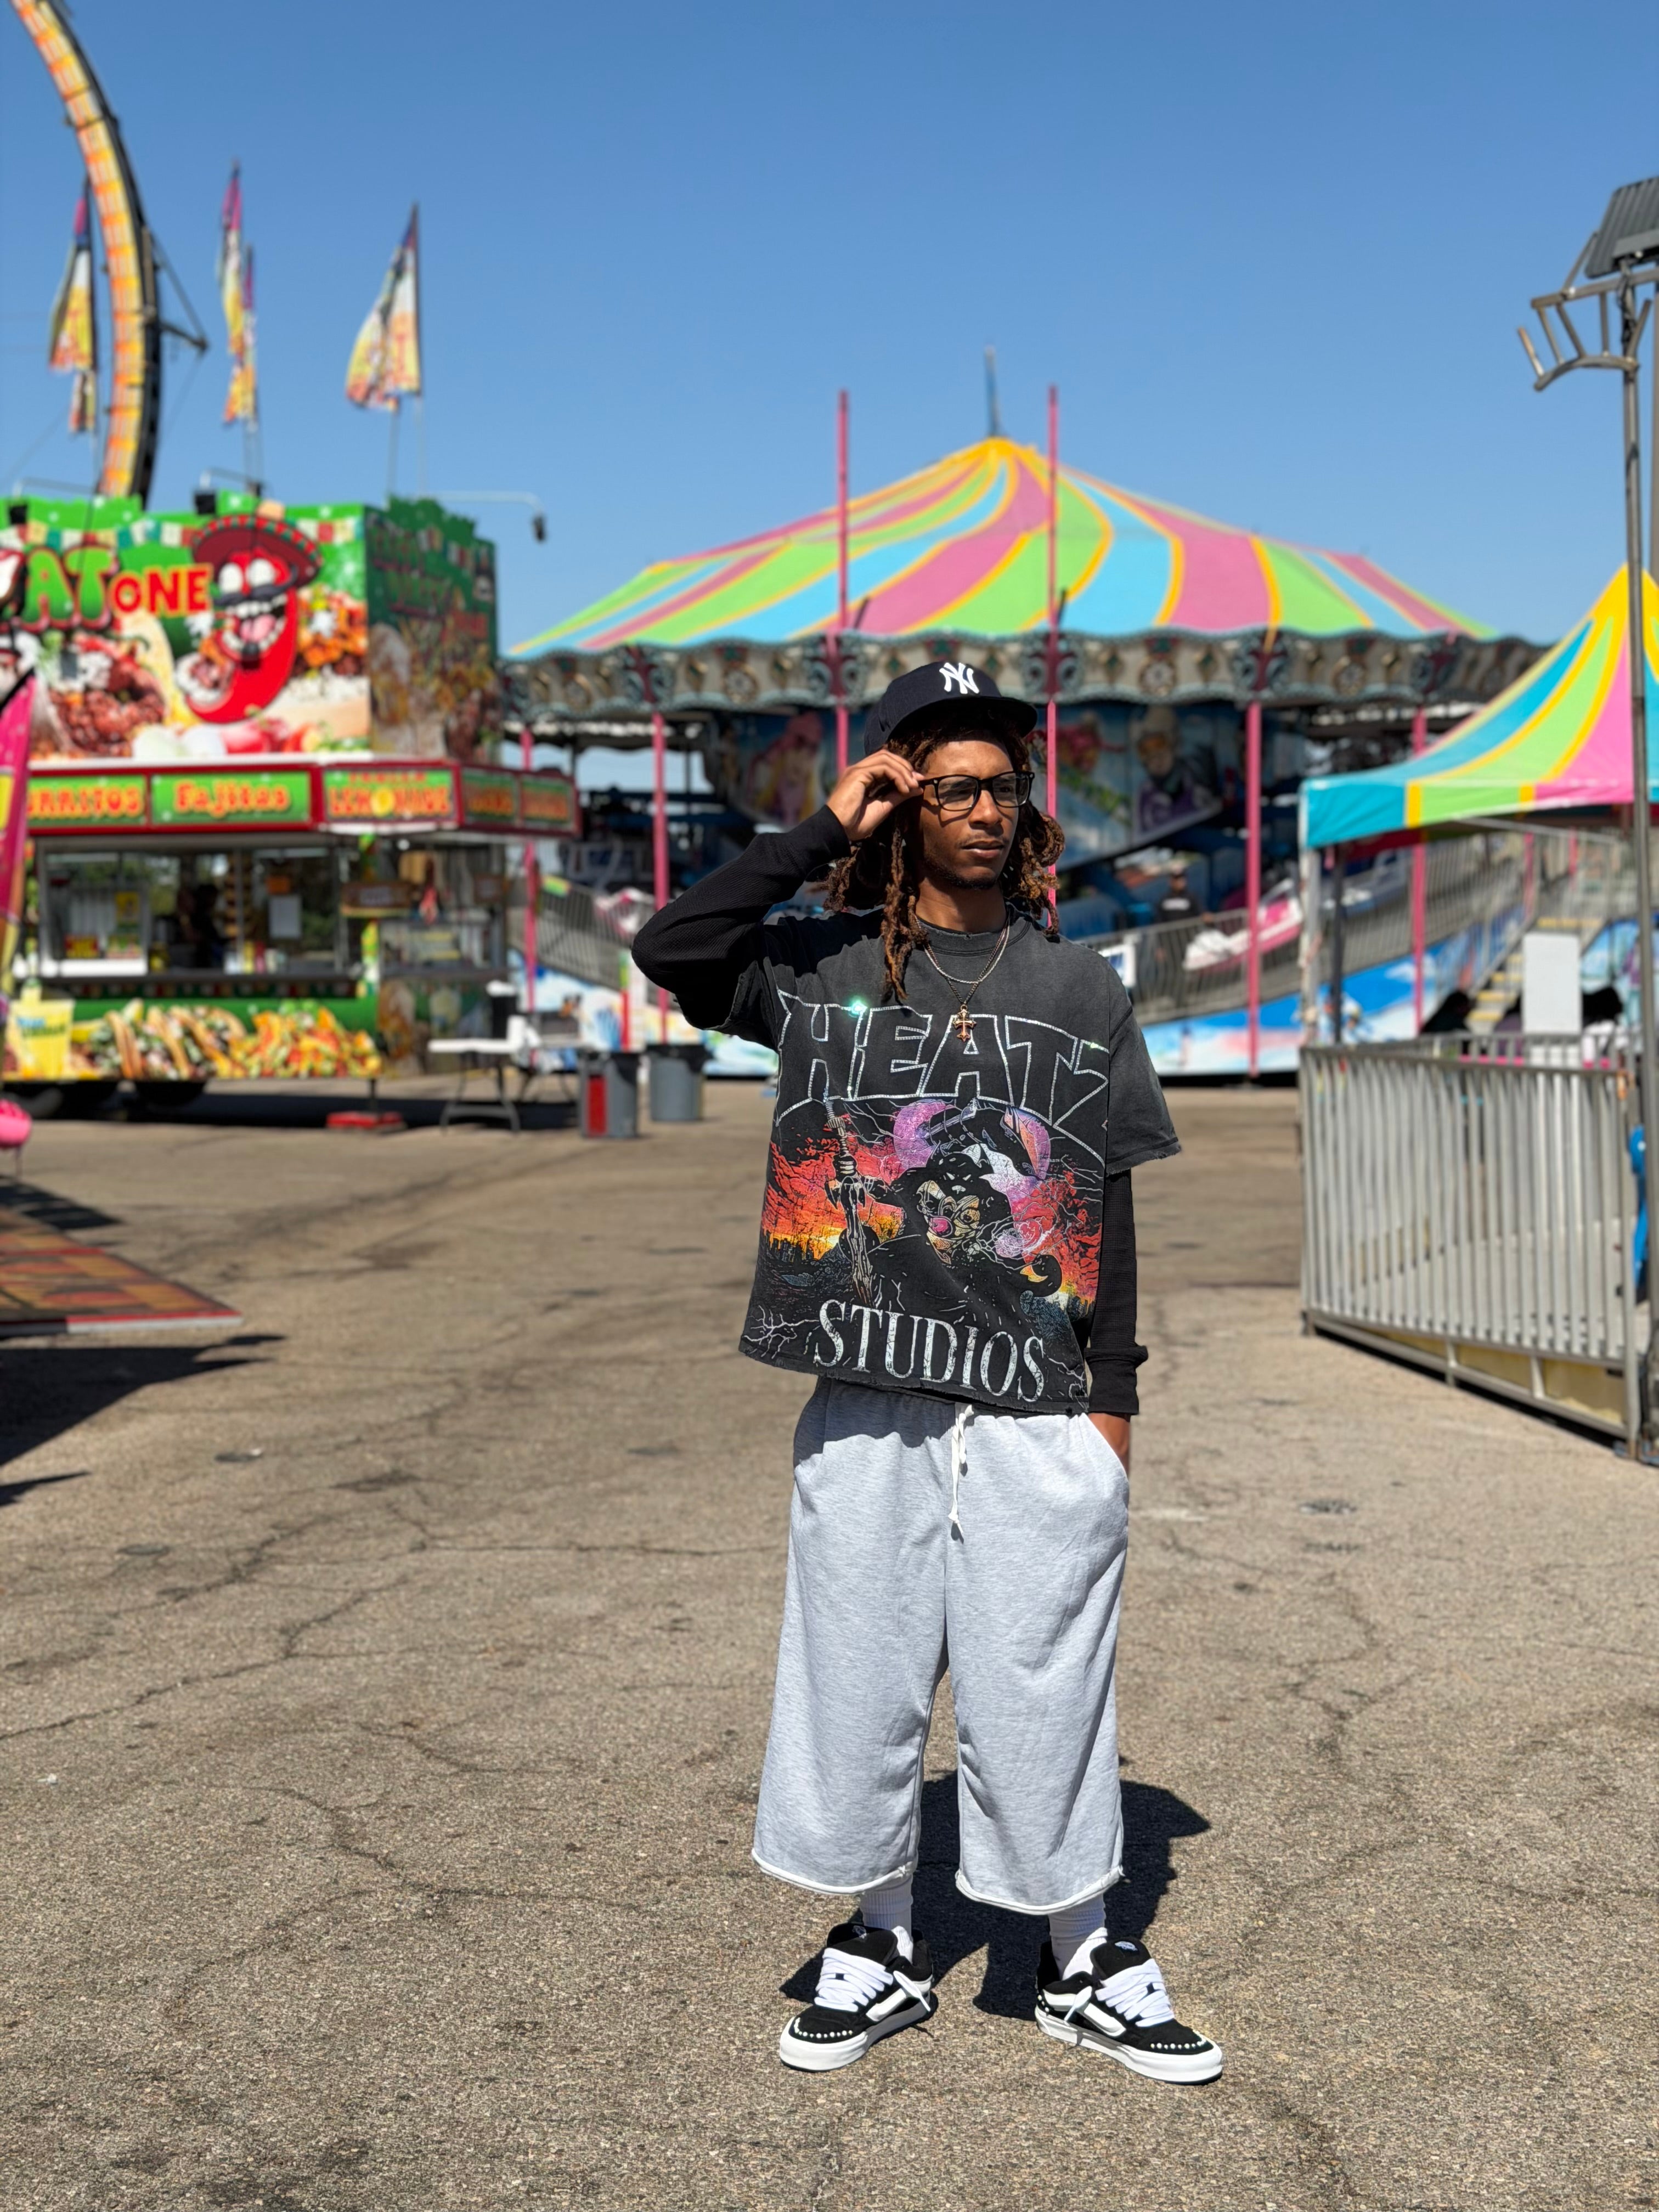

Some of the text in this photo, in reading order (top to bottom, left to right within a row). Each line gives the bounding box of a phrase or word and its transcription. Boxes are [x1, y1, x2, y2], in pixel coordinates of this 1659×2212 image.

[111, 565, 213, 615] ONE
[939, 662, 980, 694] NY
[813, 1299, 1043, 1402] STUDIOS
